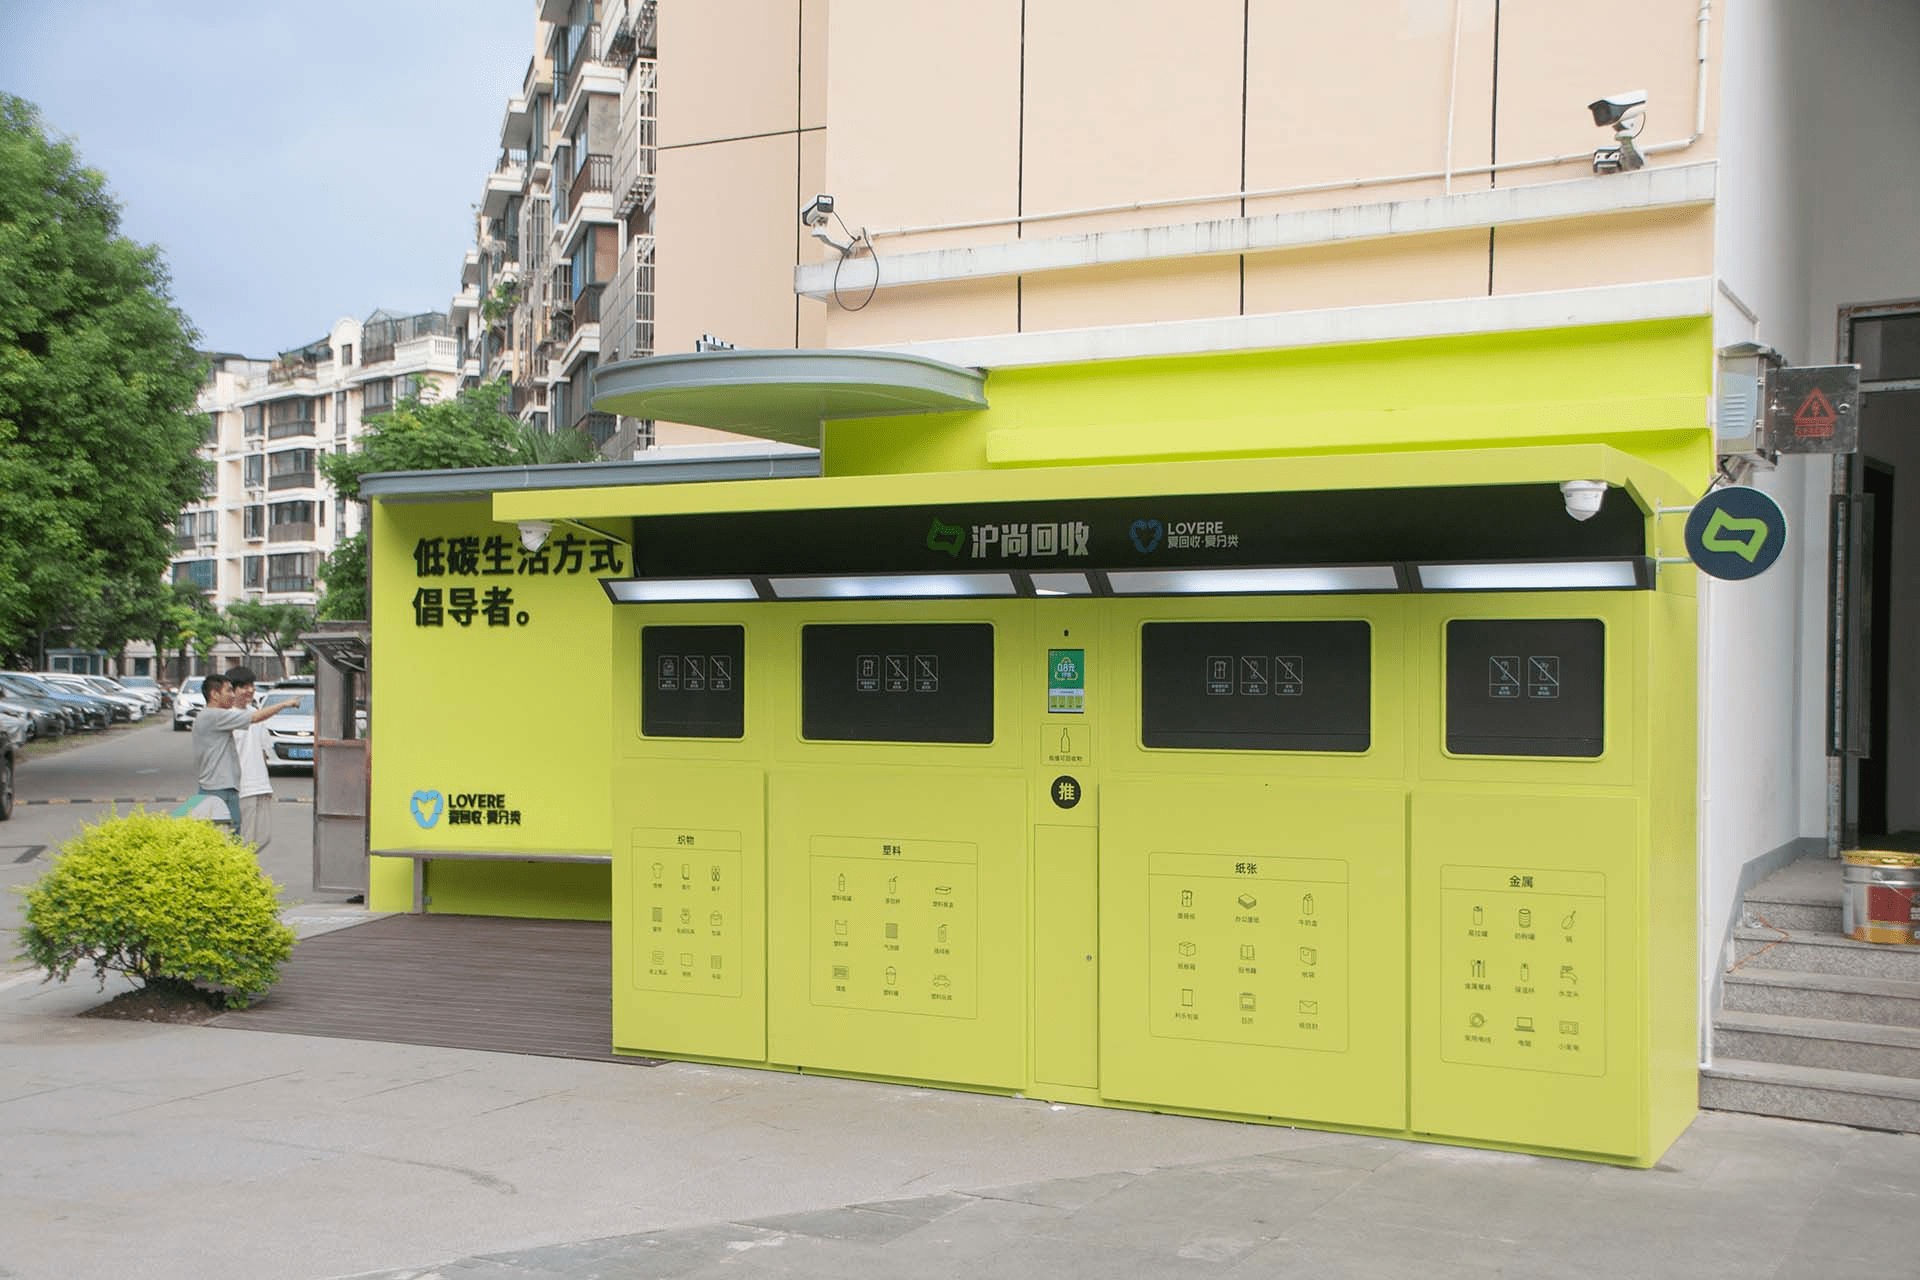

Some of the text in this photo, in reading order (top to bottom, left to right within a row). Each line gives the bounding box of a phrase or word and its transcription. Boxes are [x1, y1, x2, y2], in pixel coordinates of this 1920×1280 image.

[1167, 521, 1224, 535] LOVERE
[971, 521, 1090, 558] 沪尚回收
[413, 534, 624, 577] 低碳生活方式
[412, 586, 530, 628] 倡导者。
[1058, 782, 1075, 801] 推
[448, 793, 505, 808] LOVERE
[677, 835, 695, 846] 织物
[882, 844, 903, 857] 塑料
[1235, 862, 1258, 875] 纸张
[1509, 875, 1534, 889] 金属
